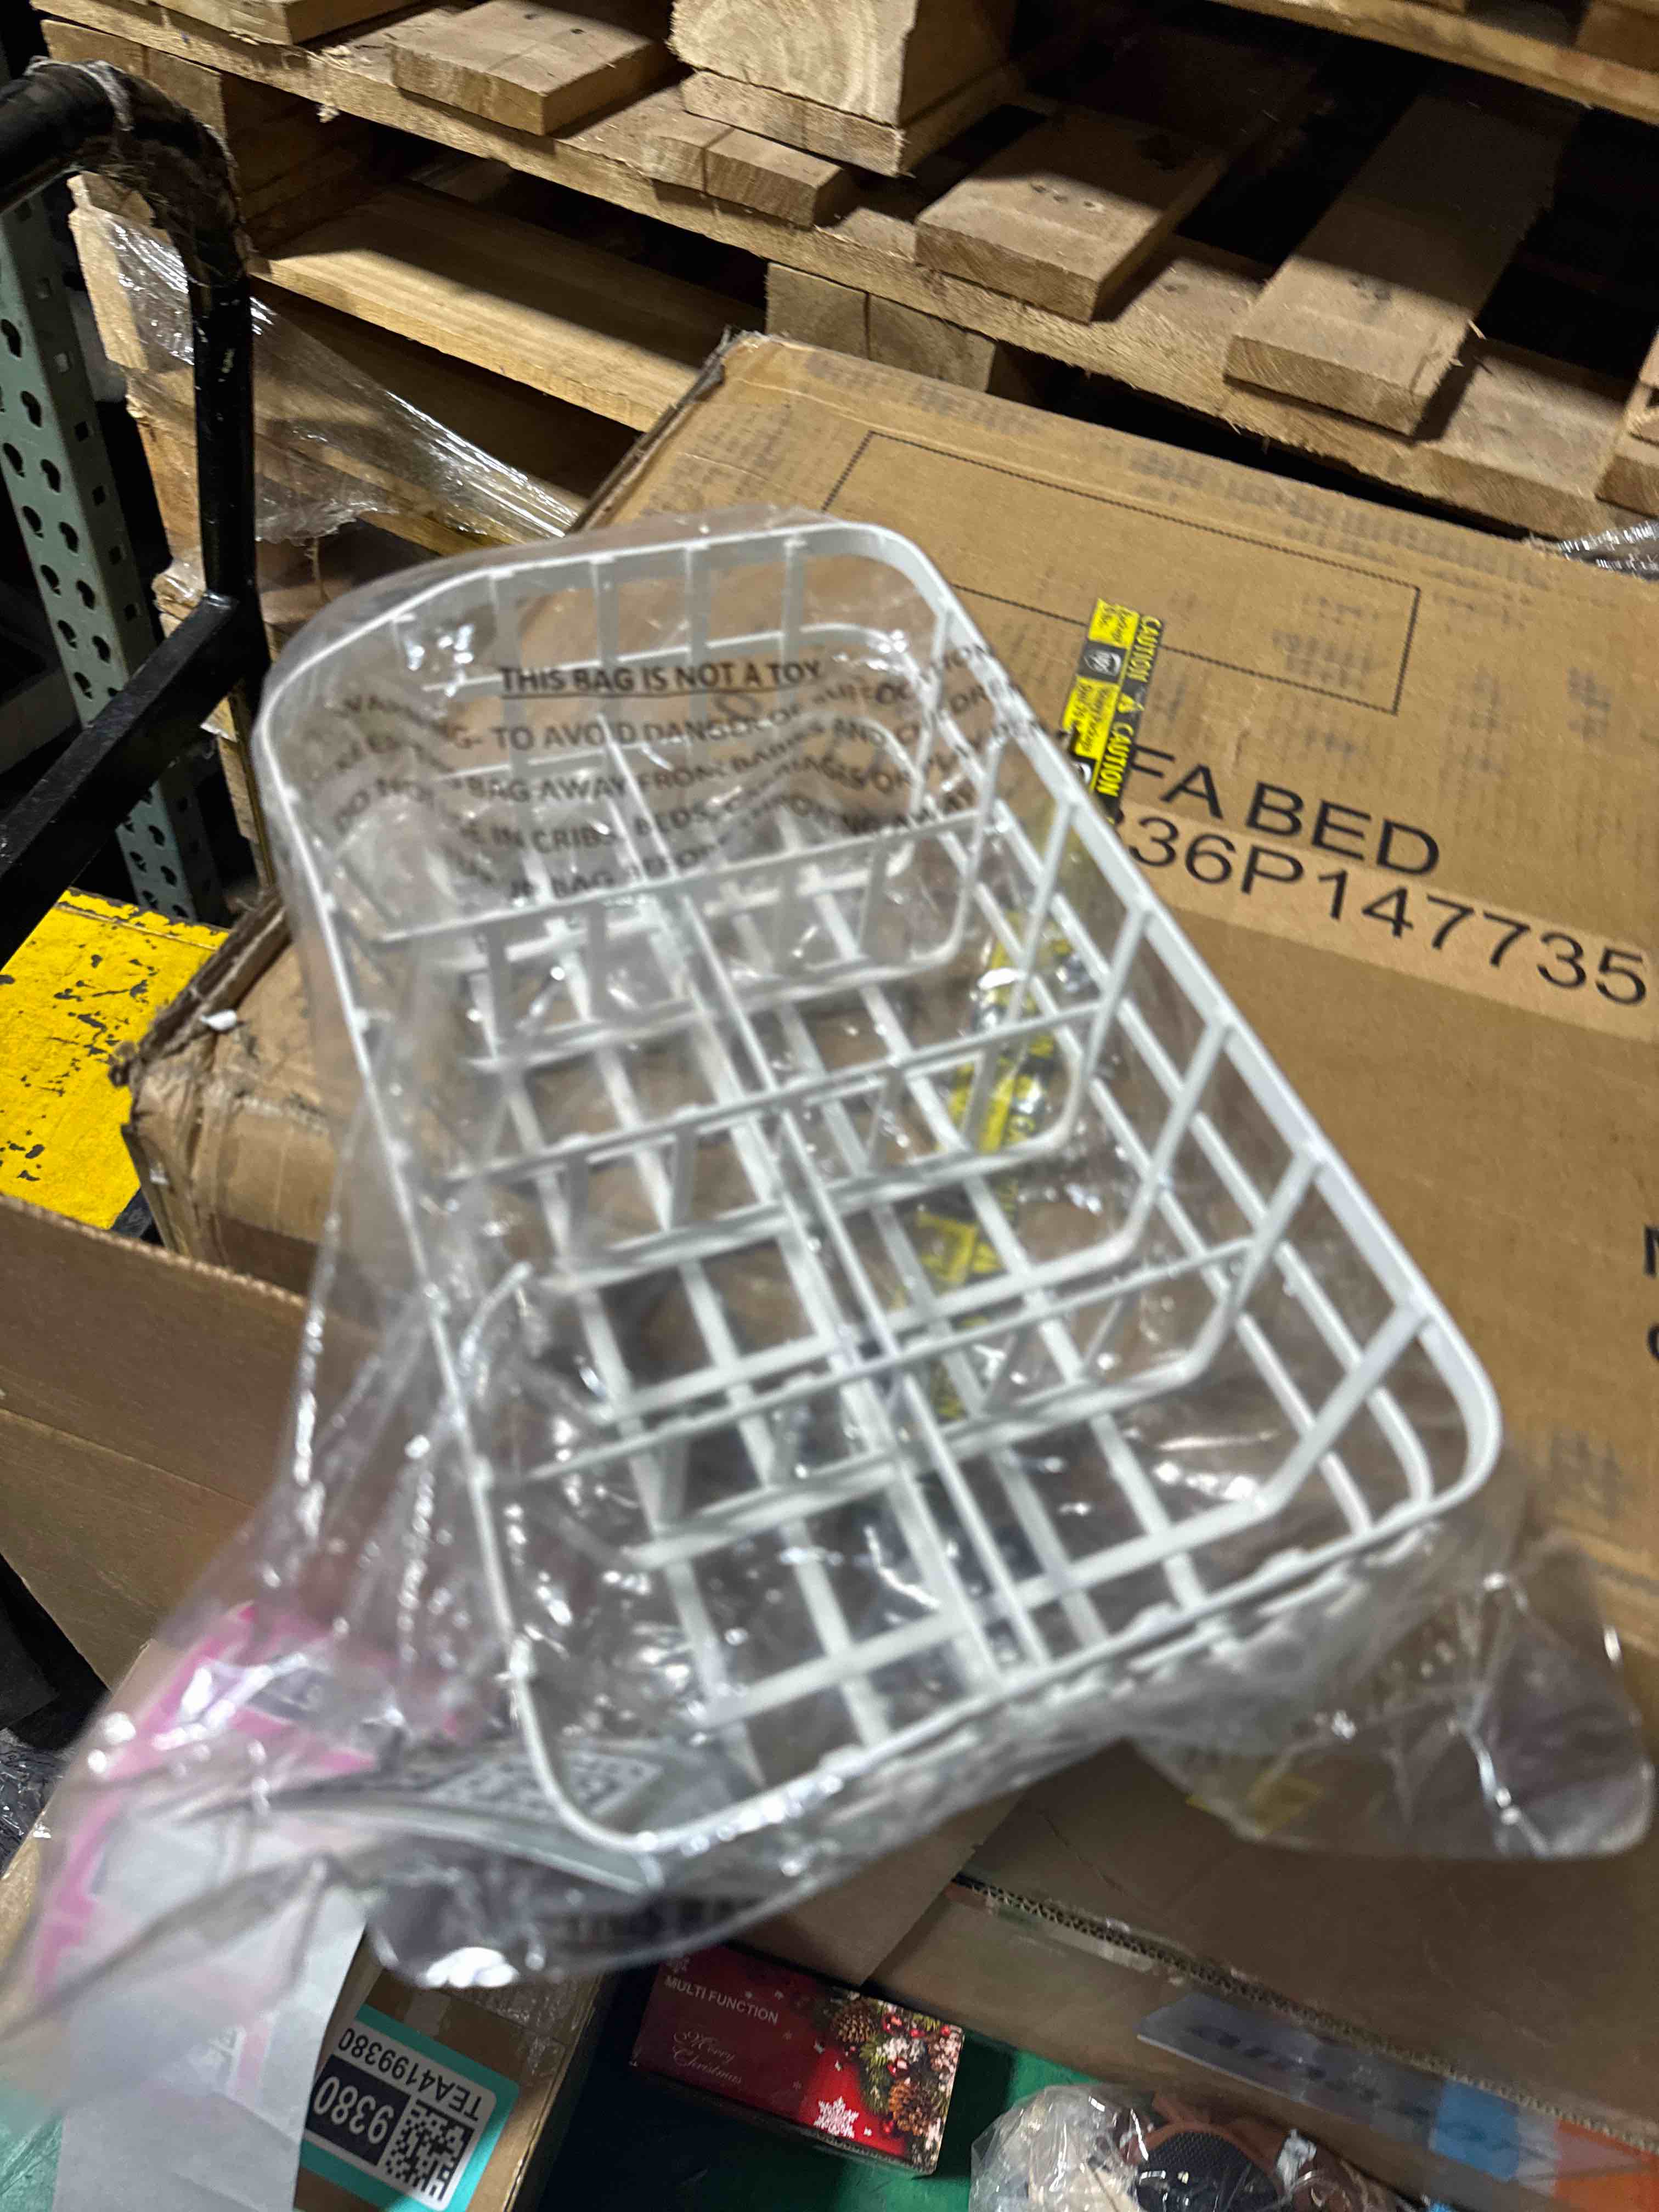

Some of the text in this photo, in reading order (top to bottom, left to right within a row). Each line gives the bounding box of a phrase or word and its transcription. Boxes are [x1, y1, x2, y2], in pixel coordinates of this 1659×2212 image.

[500, 659, 820, 692] THIS BAG IS NOT A TOY
[1126, 615, 1162, 682] CAUTION
[492, 725, 534, 751] TO
[545, 721, 635, 748] AVOD
[1096, 722, 1134, 797] CAUTION
[1246, 781, 1440, 877] BED
[1118, 809, 1646, 1006] 36P147735
[664, 1975, 778, 2024] MULTI FUNCTION
[337, 2027, 482, 2121] TEA4199380
[673, 2030, 736, 2066] Merry
[673, 2046, 742, 2085] Christmas
[313, 2076, 394, 2144] 9380
